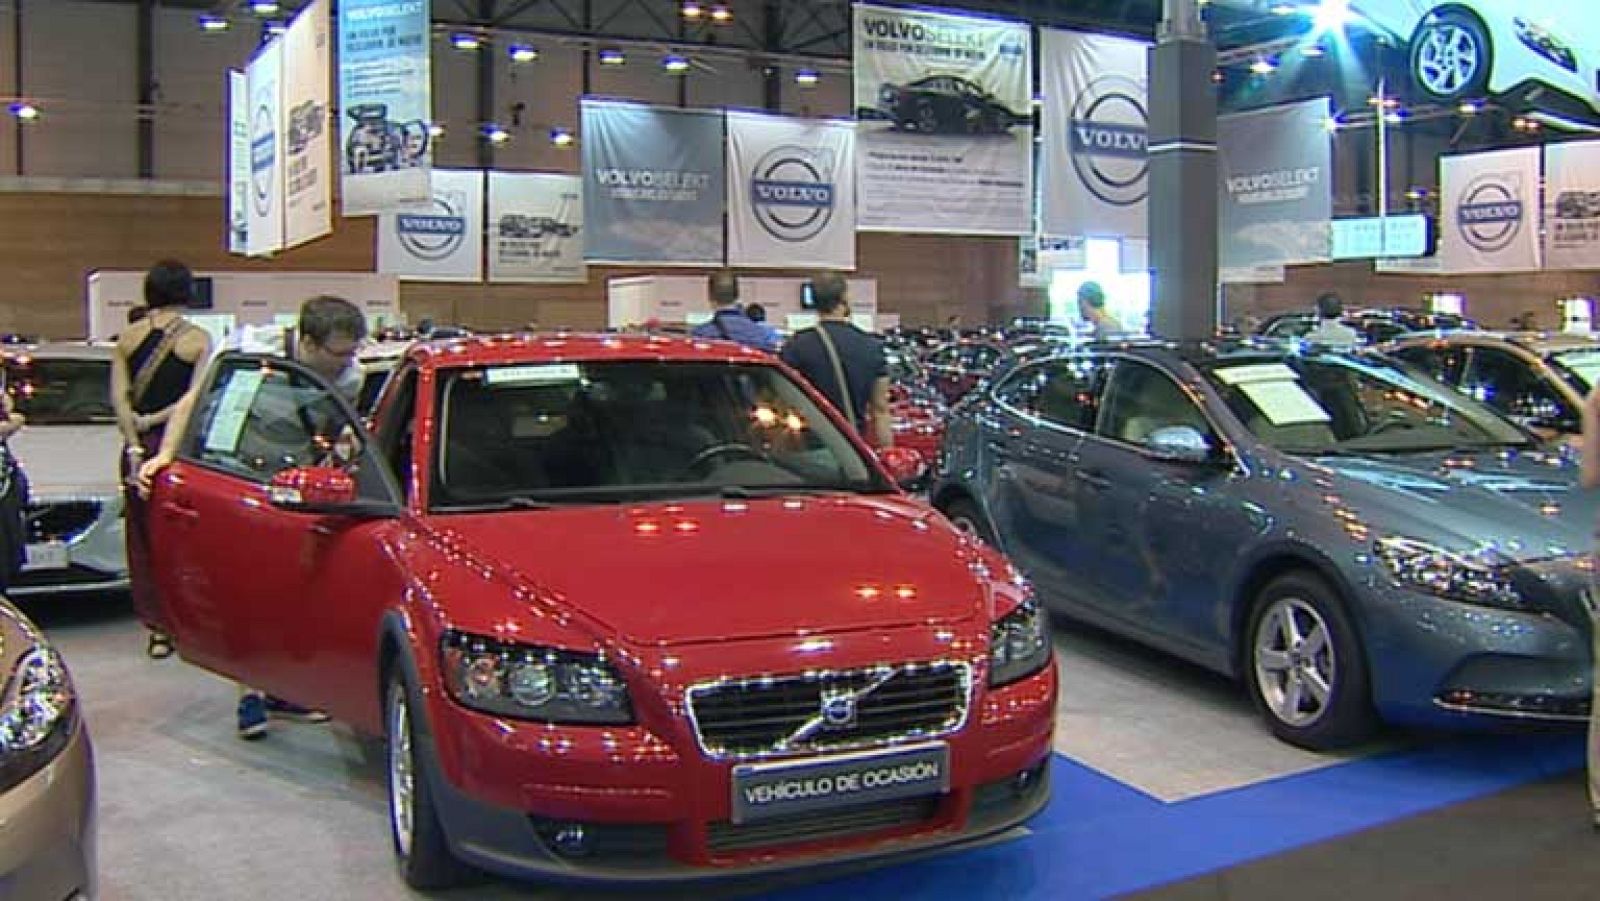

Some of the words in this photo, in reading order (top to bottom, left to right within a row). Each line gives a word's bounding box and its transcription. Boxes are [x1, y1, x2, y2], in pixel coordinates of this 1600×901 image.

[1077, 126, 1149, 149] VOLV
[596, 167, 711, 189] VOLVOSELEKT
[756, 184, 828, 201] VOLVO
[1462, 204, 1520, 218] VOLVO
[401, 218, 461, 231] VOLVO
[746, 776, 832, 803] VEHÍCULO
[834, 772, 861, 792] DE
[863, 760, 939, 787] OCASIÓN
